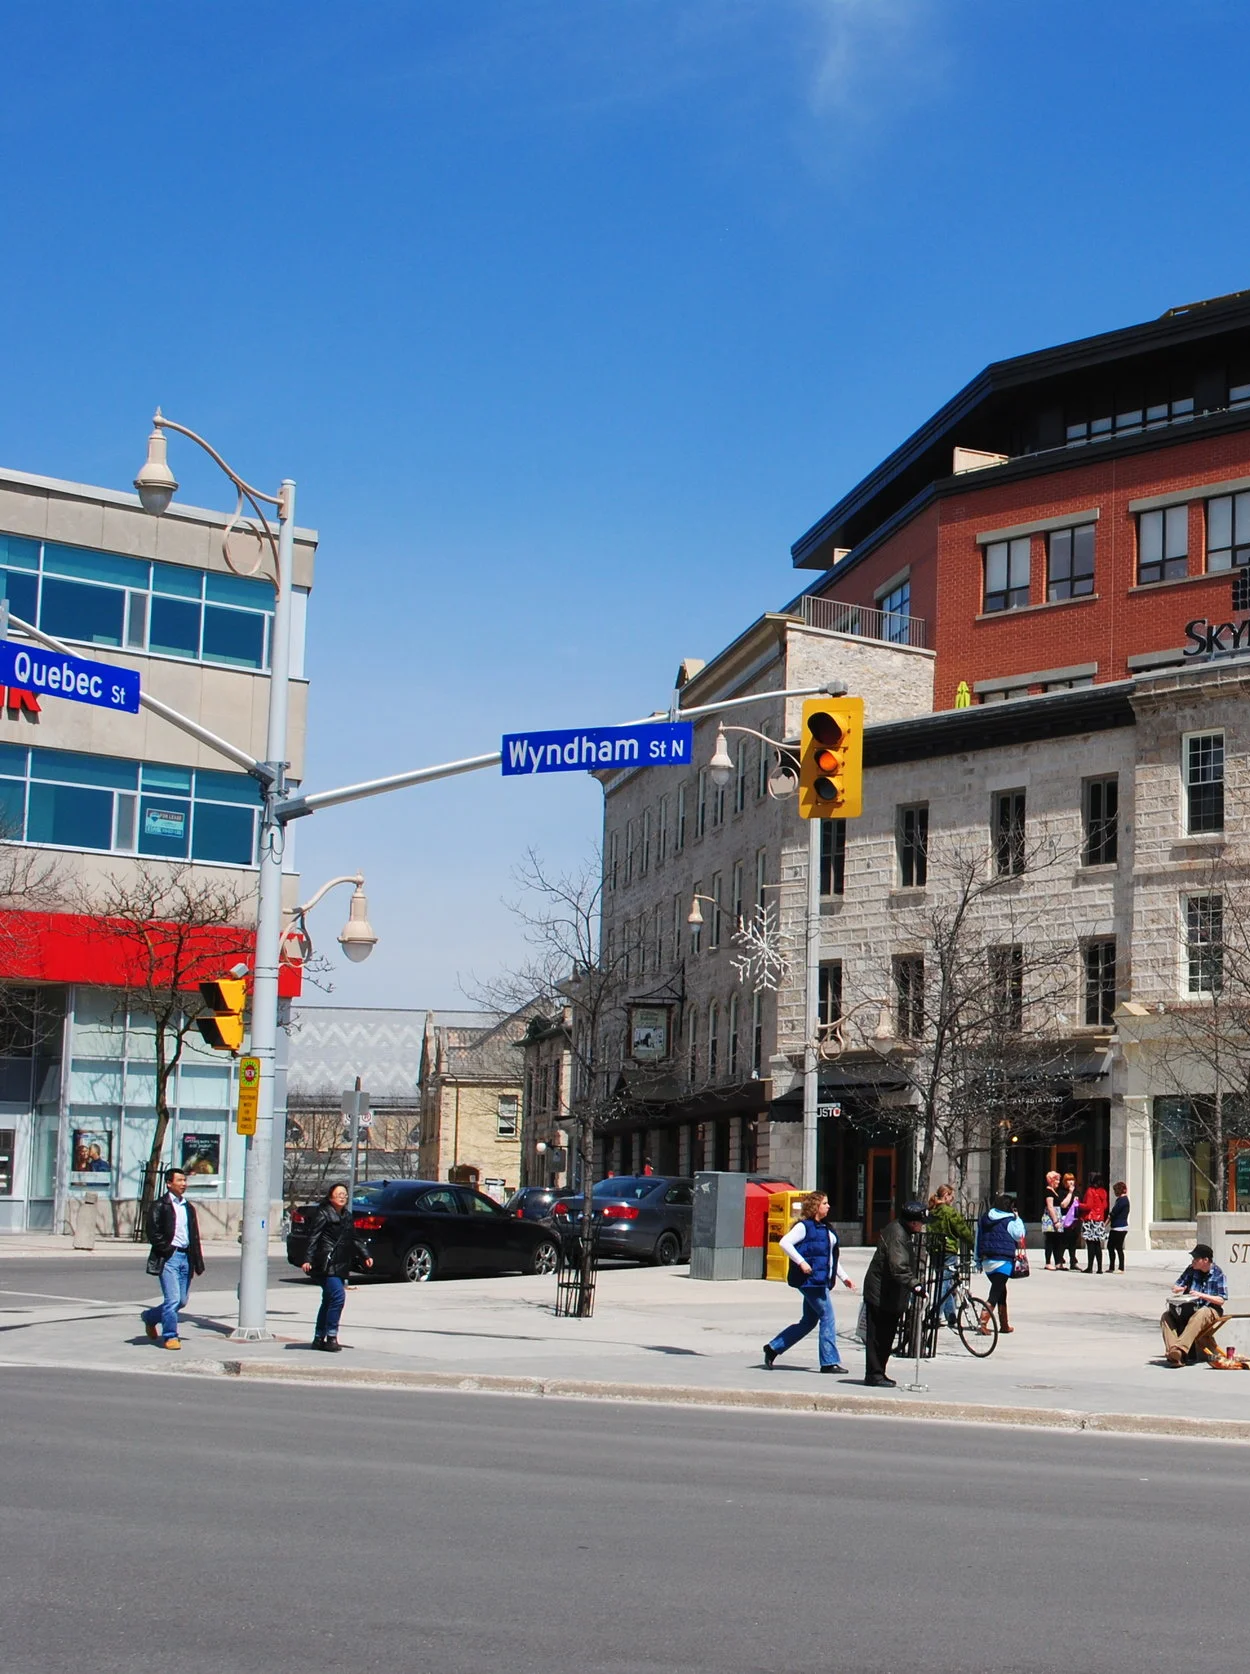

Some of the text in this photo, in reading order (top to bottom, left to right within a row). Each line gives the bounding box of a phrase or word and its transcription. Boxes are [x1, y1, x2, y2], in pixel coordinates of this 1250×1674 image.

[14, 651, 103, 699] Quebec
[110, 685, 126, 705] St
[508, 736, 684, 774] Wyndham St N
[816, 1107, 841, 1118] USTO
